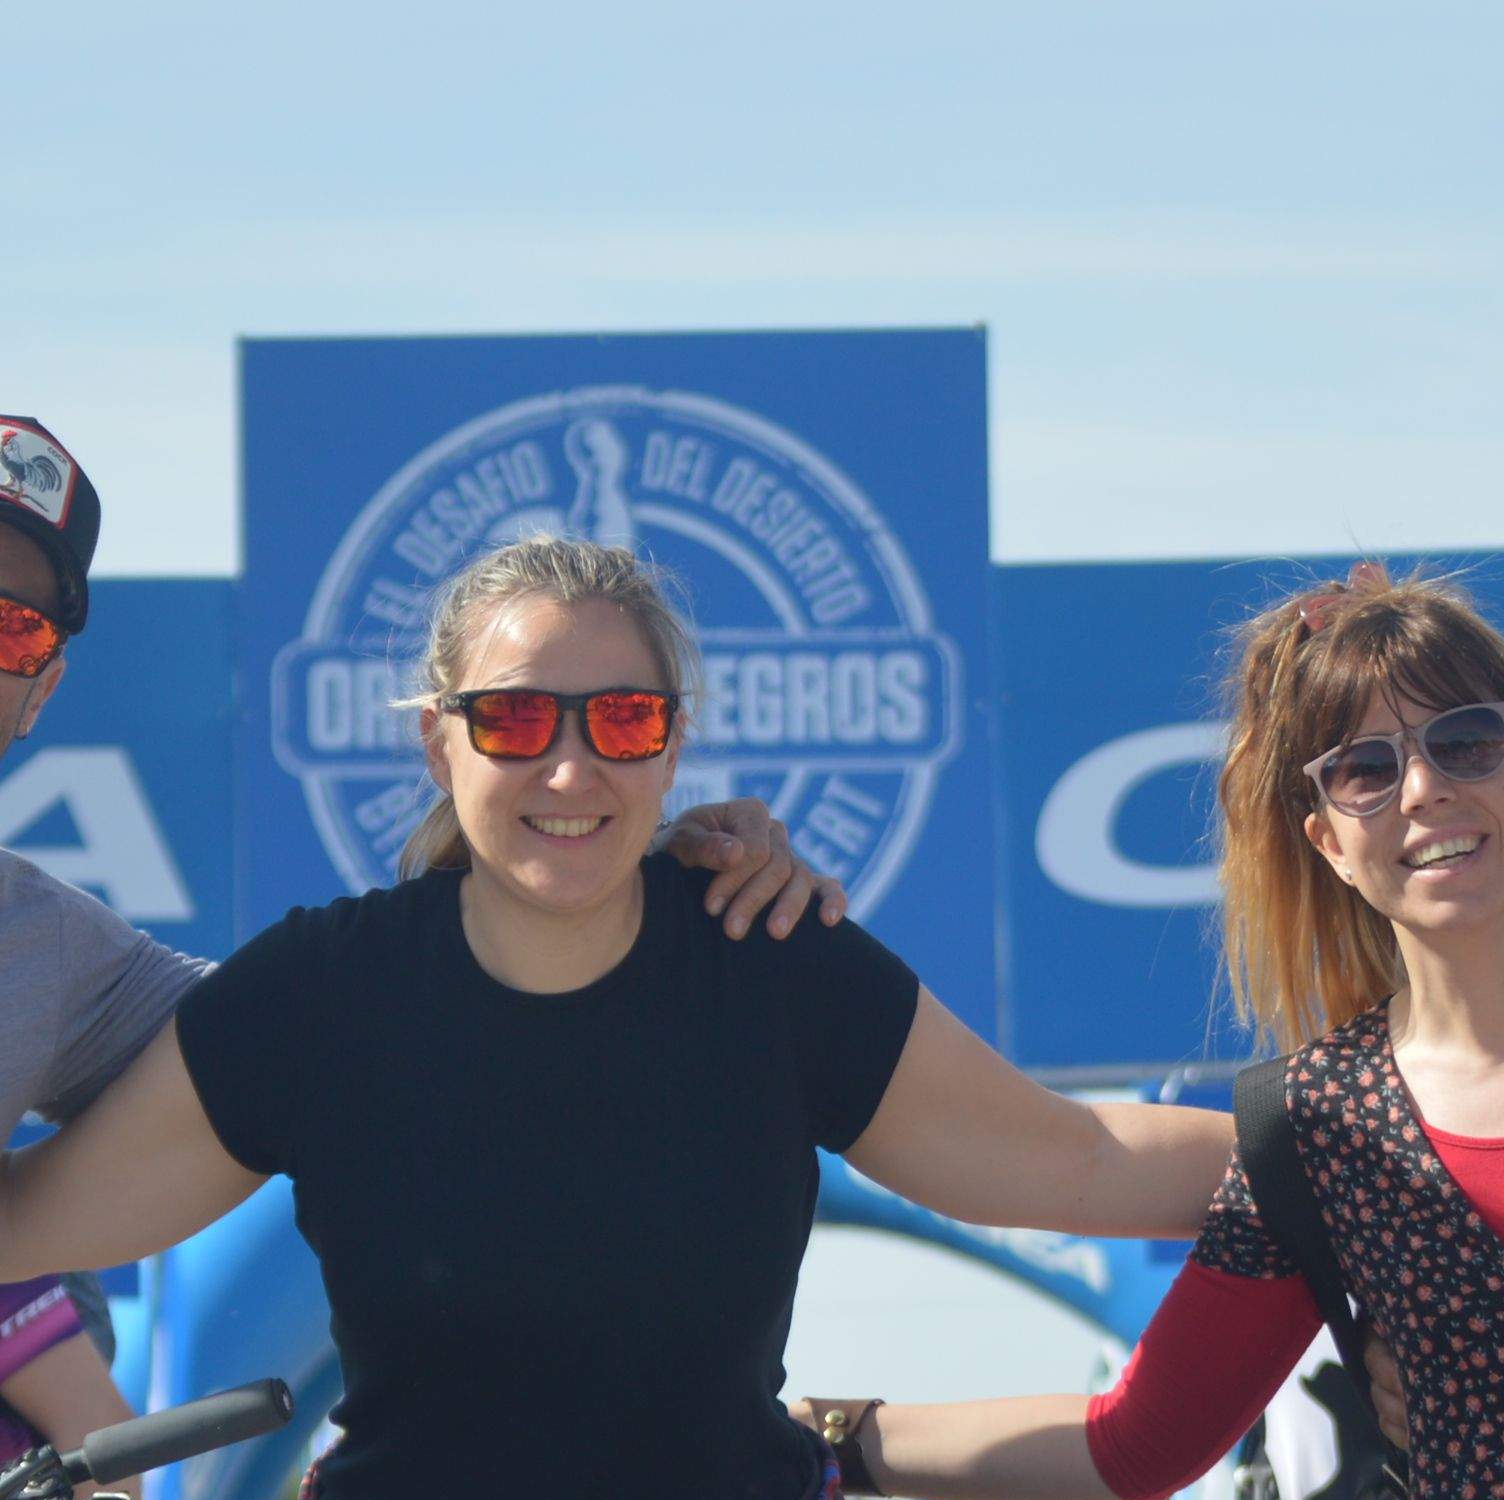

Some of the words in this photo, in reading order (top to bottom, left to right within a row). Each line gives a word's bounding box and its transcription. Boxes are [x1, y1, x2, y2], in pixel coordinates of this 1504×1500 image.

[393, 440, 555, 574] DESAFIO
[641, 431, 714, 501] DEL
[711, 457, 870, 624] DESIERTO
[706, 650, 925, 746] EGROS
